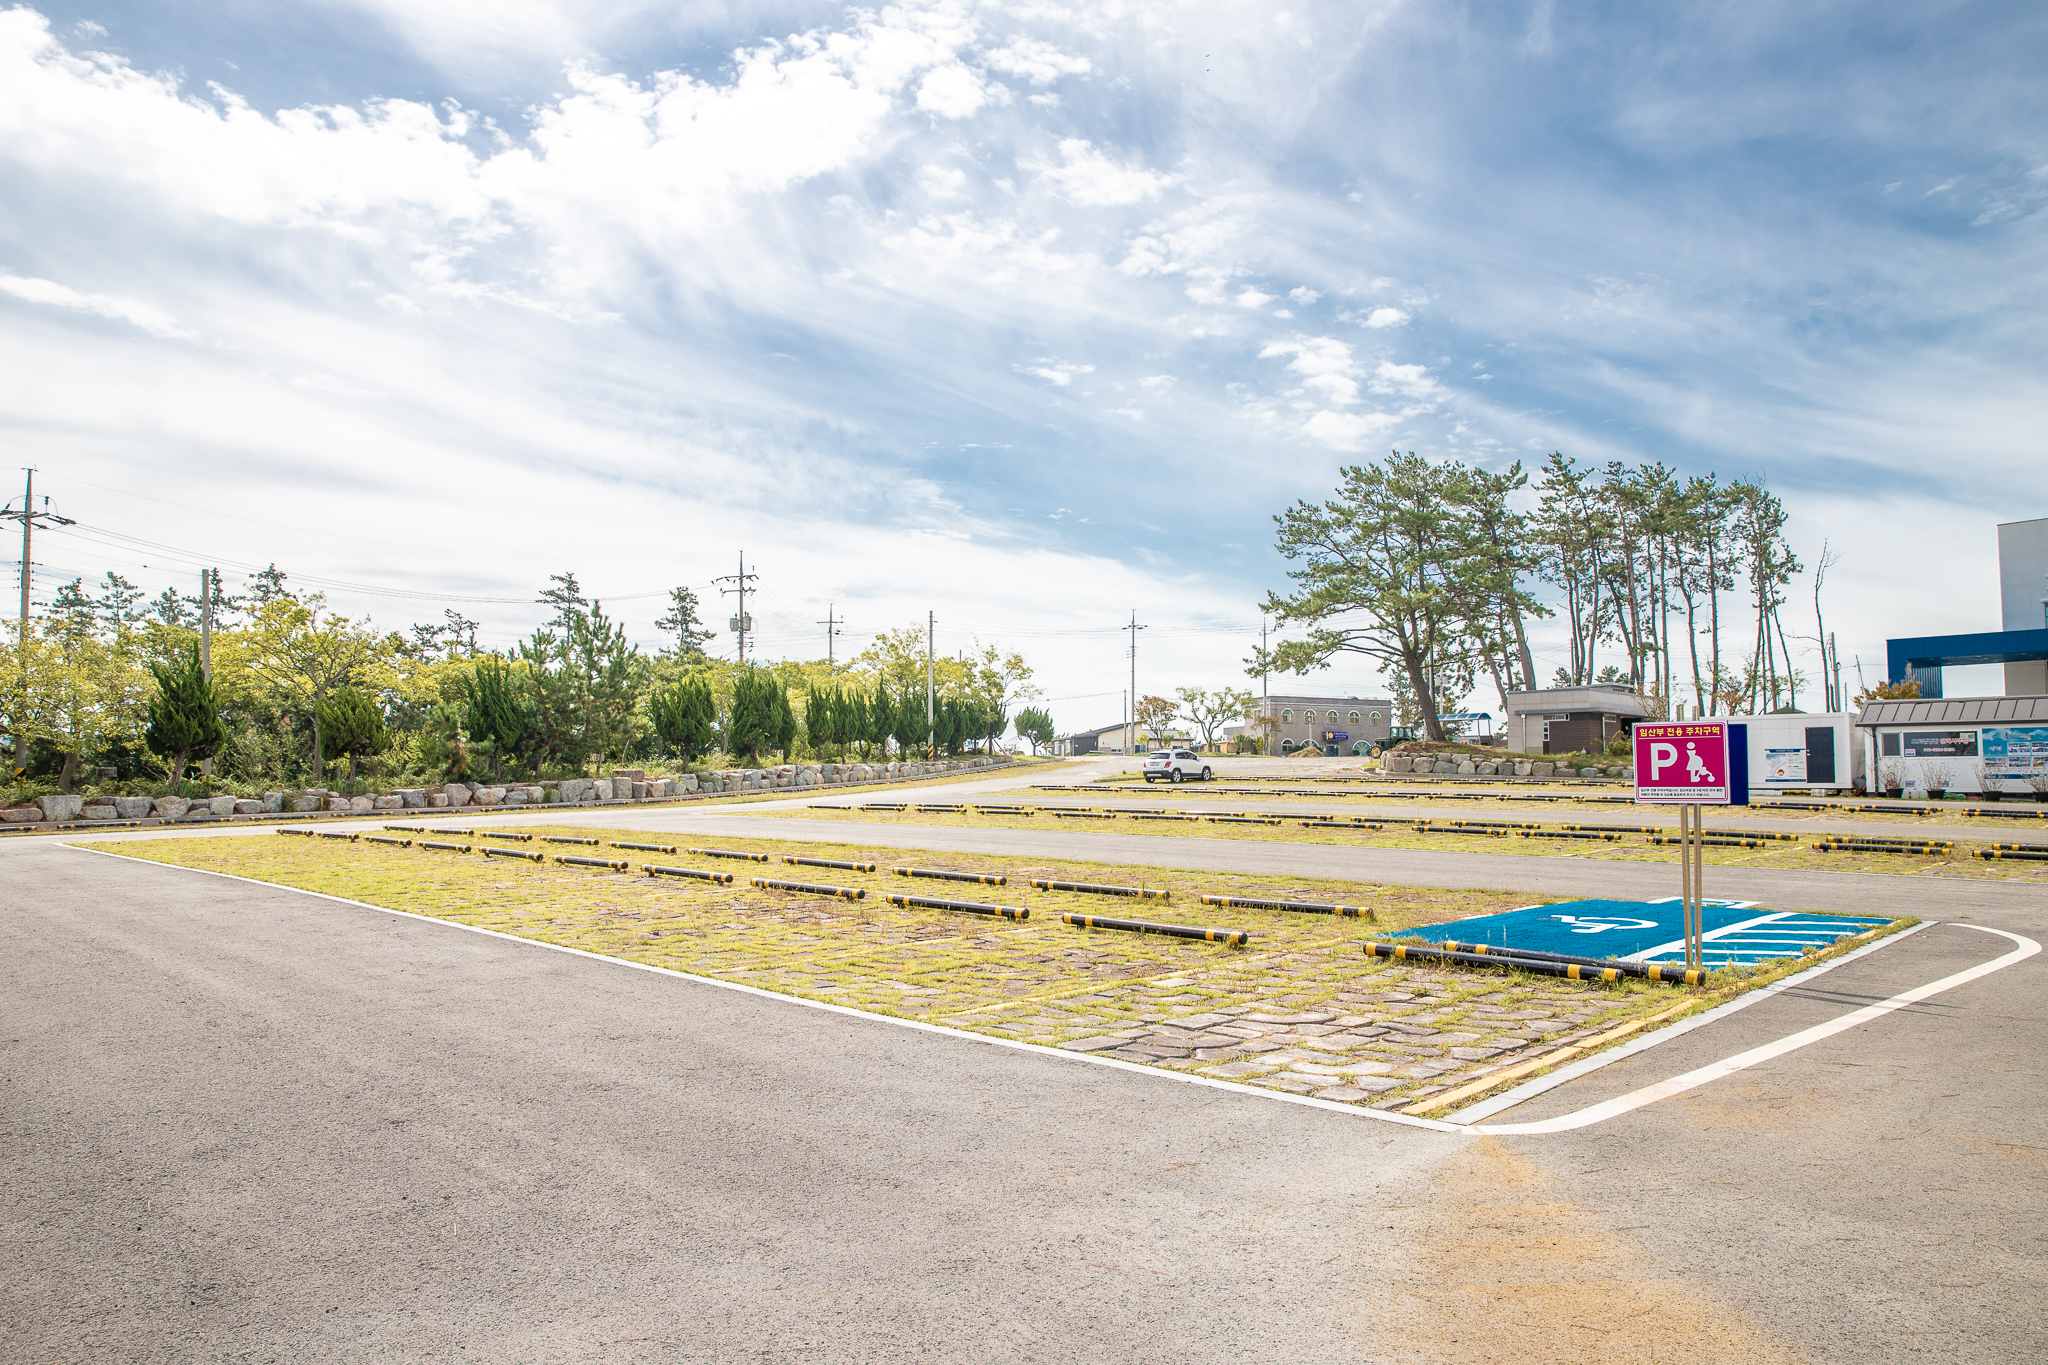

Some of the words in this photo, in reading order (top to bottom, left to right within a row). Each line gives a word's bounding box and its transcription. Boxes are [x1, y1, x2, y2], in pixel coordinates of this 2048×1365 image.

[1640, 728, 1664, 737] 임산부
[1667, 727, 1683, 736] 전용
[1686, 726, 1719, 735] 주차구역
[1650, 743, 1678, 780] P
